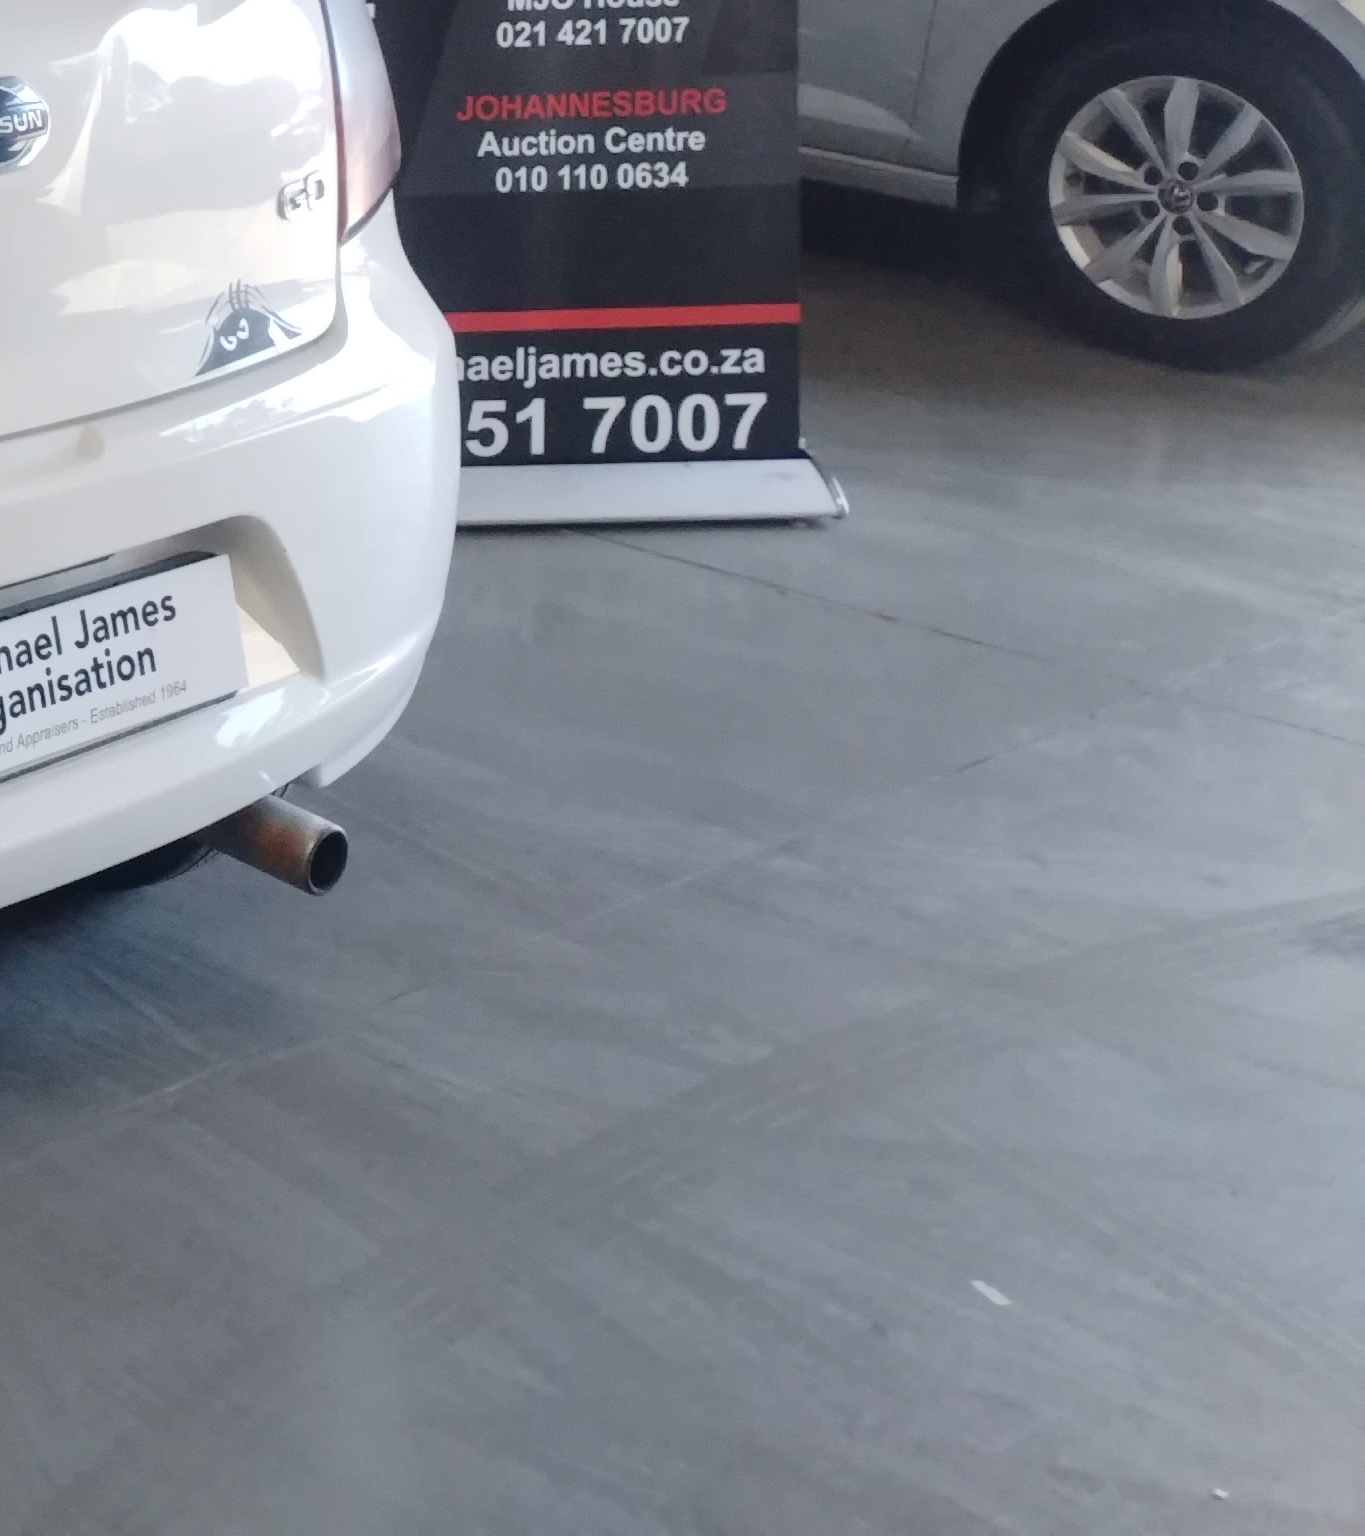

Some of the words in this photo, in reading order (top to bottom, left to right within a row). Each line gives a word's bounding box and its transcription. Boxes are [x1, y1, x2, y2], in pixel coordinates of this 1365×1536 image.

[496, 20, 547, 48] 021
[556, 18, 607, 46] 421
[619, 16, 690, 44] 7007
[456, 88, 730, 121] JOHANNESBURG
[477, 129, 595, 158] Auction
[605, 126, 706, 154] Centre
[495, 165, 548, 193] 010
[557, 163, 608, 191] 110
[617, 161, 690, 189] 0634
[583, 392, 768, 454] 7007
[73, 593, 177, 650] James
[16, 718, 80, 753] Appraisers
[89, 693, 157, 725] Established
[159, 679, 188, 703] 1964
